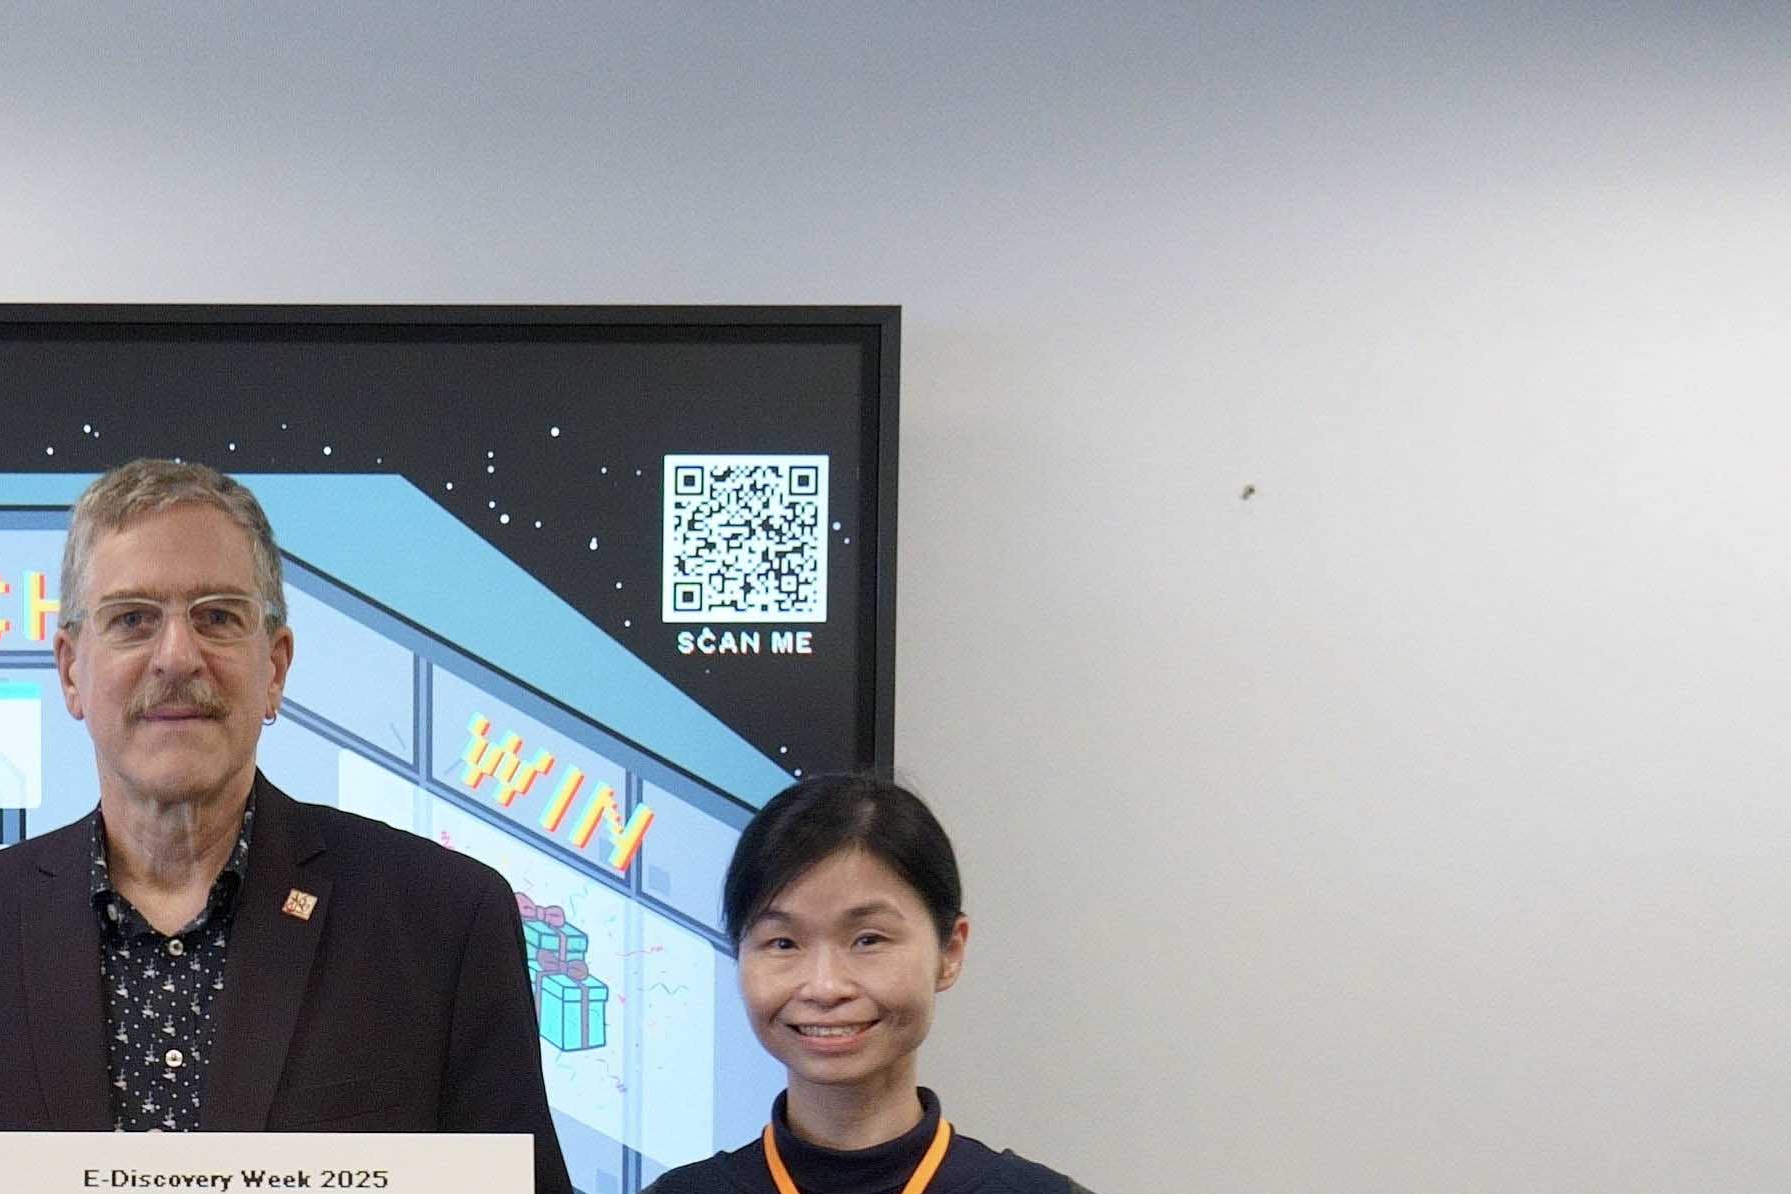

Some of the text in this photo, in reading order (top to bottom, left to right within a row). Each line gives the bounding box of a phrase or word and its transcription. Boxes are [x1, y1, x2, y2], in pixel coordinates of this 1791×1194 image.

[676, 631, 813, 655] SCAN ME
[462, 710, 655, 872] WIN
[83, 1169, 389, 1193] E-Discovery Week 2025
